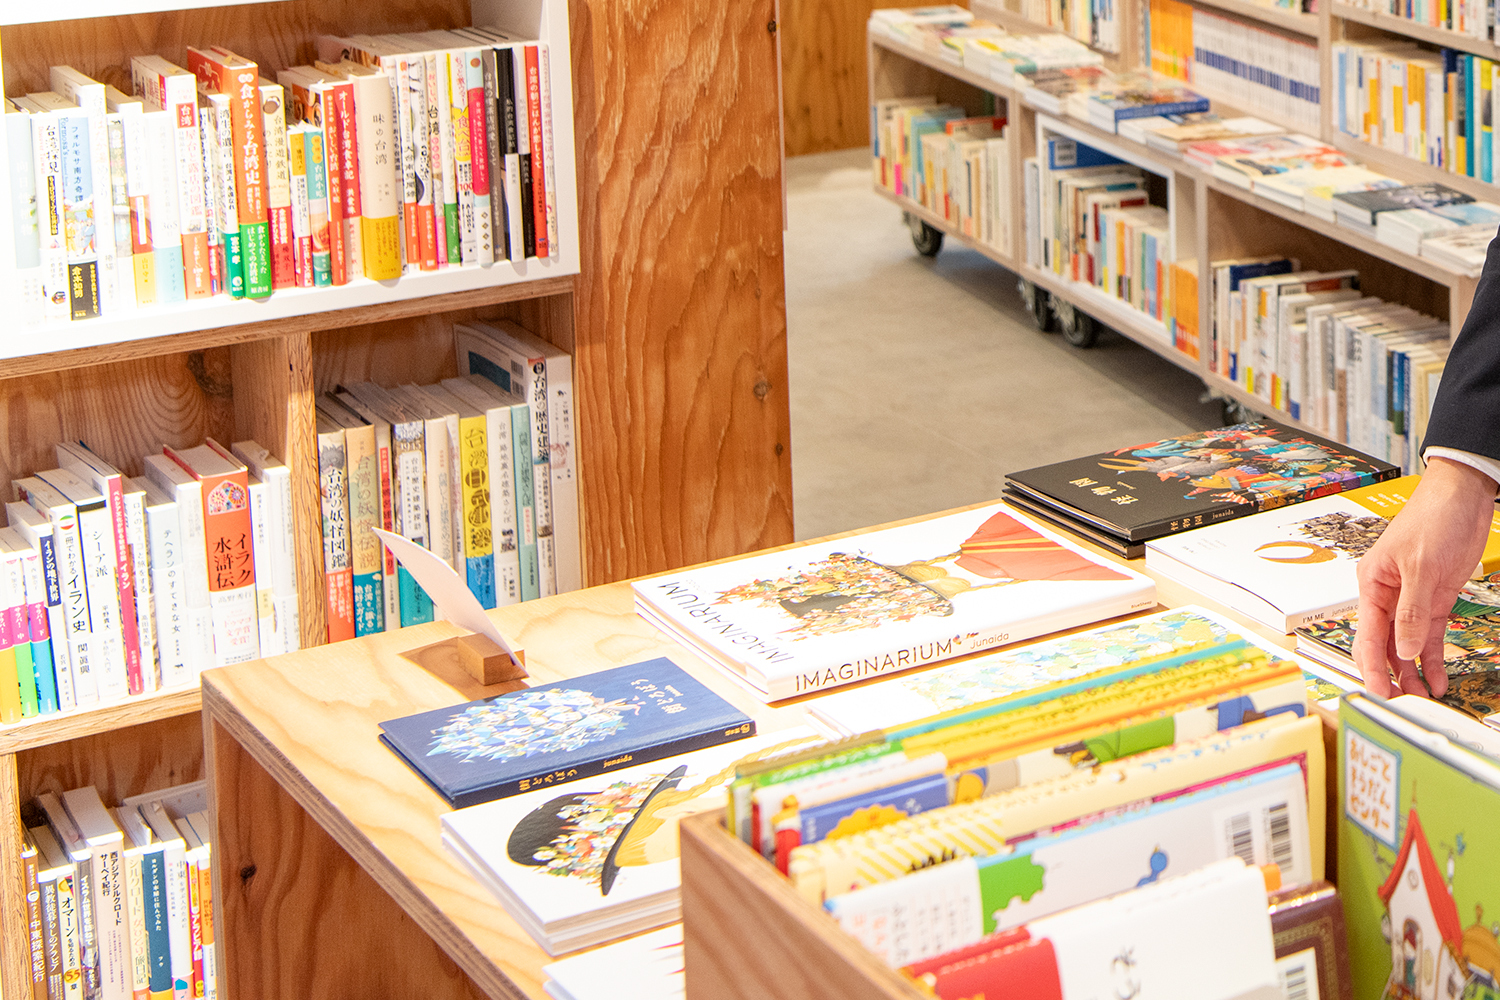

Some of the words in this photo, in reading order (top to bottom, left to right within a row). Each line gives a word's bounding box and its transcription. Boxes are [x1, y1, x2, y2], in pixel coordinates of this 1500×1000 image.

[180, 104, 193, 128] 台湾
[372, 113, 388, 166] 味の台湾
[1069, 477, 1139, 506] 怪物園
[327, 469, 348, 568] 台湾の妖怪図鑑
[1170, 514, 1204, 532] 怪物園
[1211, 508, 1235, 520] junaida
[212, 537, 236, 588] 水滸伝
[234, 532, 253, 586] イラク
[656, 580, 794, 665] IMAGINARIUM
[1314, 613, 1325, 622] ME
[795, 636, 953, 692] IMAGINARIUM
[518, 766, 578, 792] 街どろぼう
[603, 754, 633, 768] junaida
